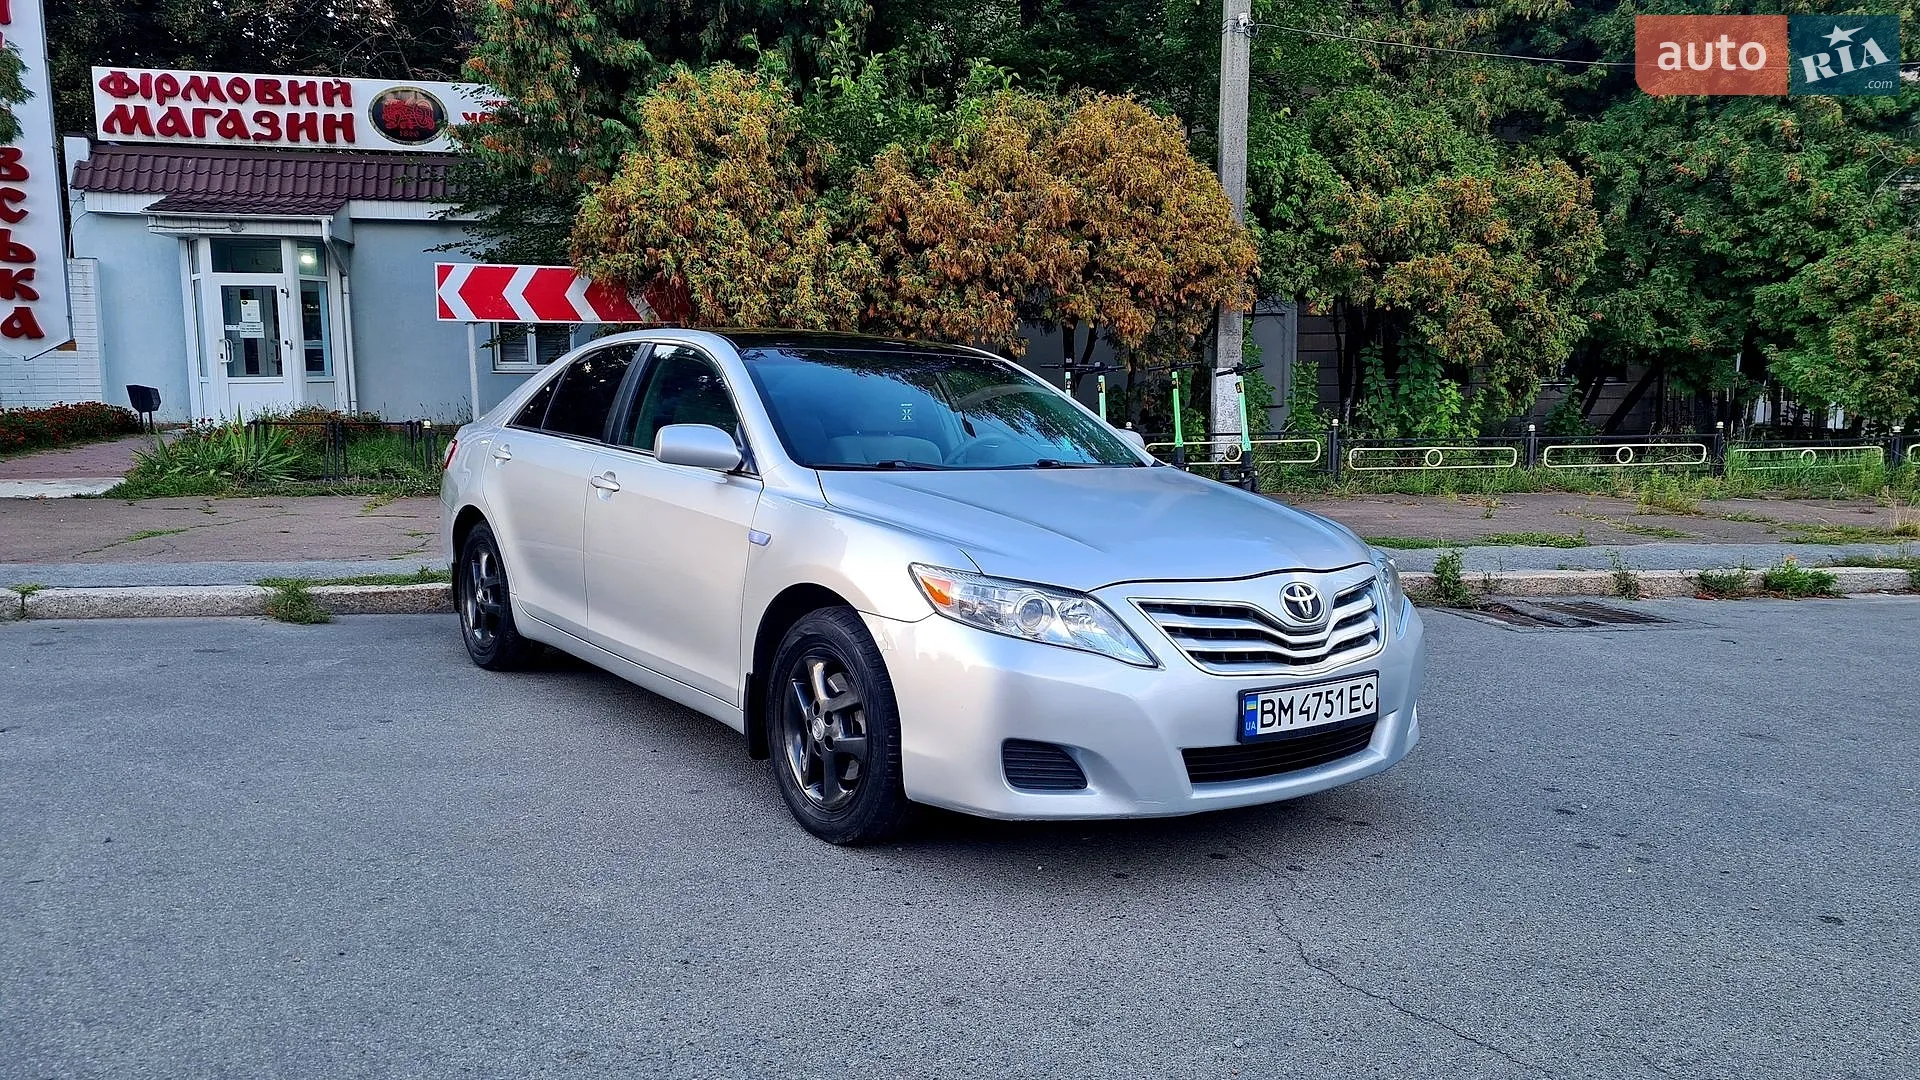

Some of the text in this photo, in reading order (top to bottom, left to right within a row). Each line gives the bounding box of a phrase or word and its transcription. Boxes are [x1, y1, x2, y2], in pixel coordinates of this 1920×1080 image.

[98, 71, 353, 107] ФІРМОВИЙ
[102, 104, 356, 144] МАГАЗИН
[1260, 682, 1374, 729] BM 4751 EC
[1245, 721, 1257, 731] UA
